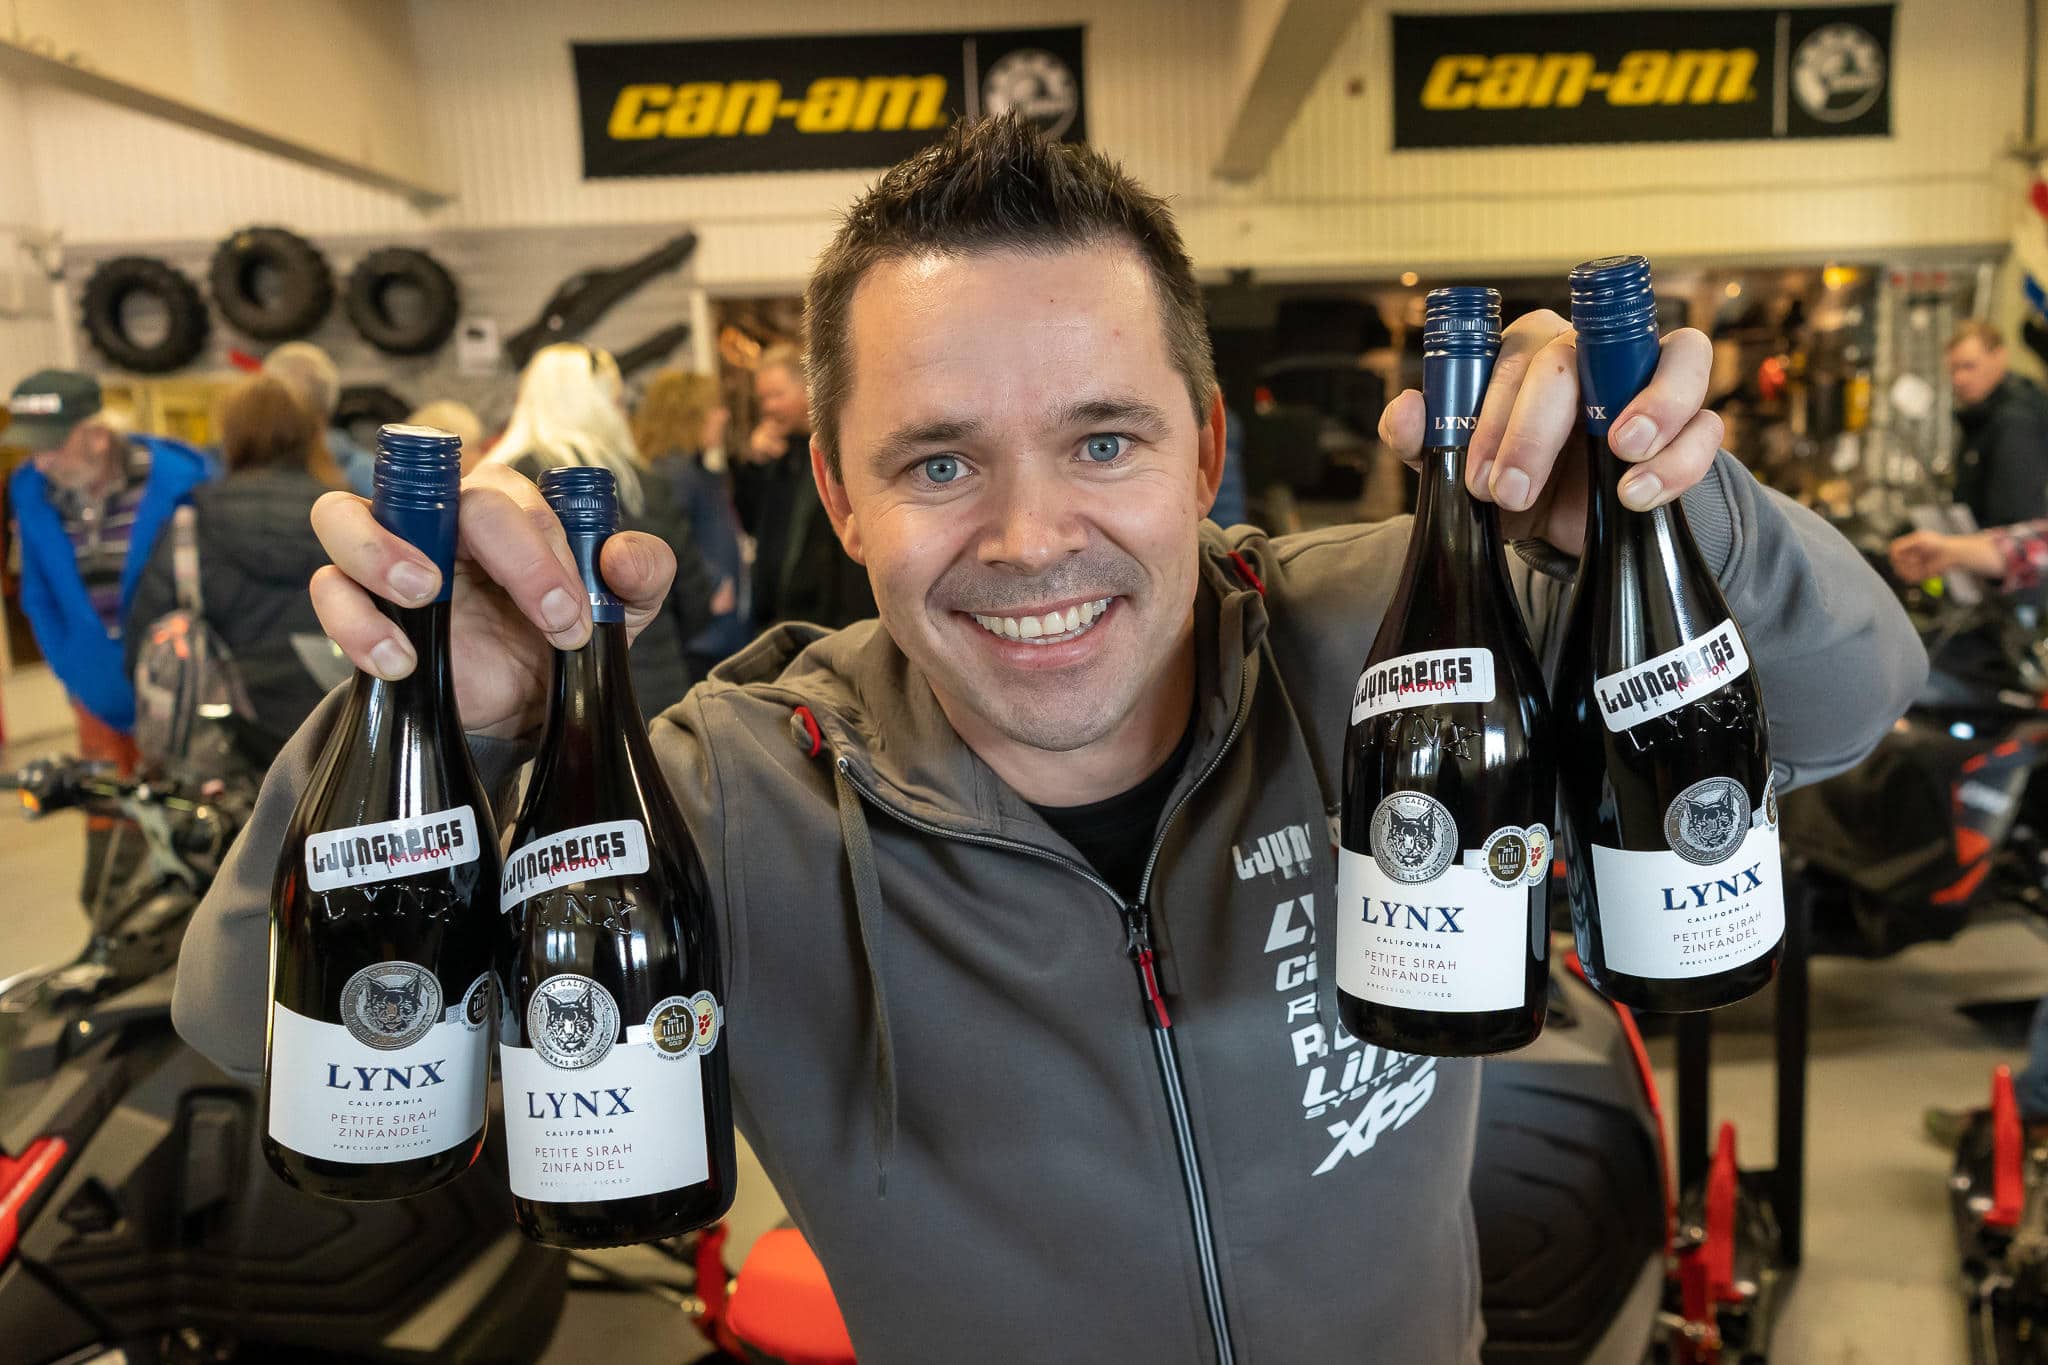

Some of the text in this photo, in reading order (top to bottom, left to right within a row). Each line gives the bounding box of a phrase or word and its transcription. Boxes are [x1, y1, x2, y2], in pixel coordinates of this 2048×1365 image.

[1420, 48, 1757, 109] can-am
[607, 74, 948, 140] can-am
[1399, 680, 1456, 696] Motor
[389, 847, 450, 867] Motor
[550, 855, 610, 877] Motor
[1661, 862, 1763, 911] LYNX
[1361, 896, 1465, 933] LYNX
[1687, 903, 1751, 923] CALIFORNIA
[1673, 912, 1762, 943] PETITE SIRAH
[1376, 936, 1442, 949] CALIFORNIA
[1682, 927, 1758, 954] ZINFANDEL
[1365, 950, 1457, 970] PETITE SIRAH
[1370, 965, 1449, 984] ZINFANDEL
[326, 1059, 447, 1091] LYNX
[348, 1097, 423, 1107] CALIFORNIA
[526, 1087, 635, 1119] LYNX
[331, 1109, 437, 1126] PETITE SIRAH
[338, 1126, 429, 1138] ZINFANDEL
[545, 1128, 615, 1137] CALIFORNIA
[535, 1143, 632, 1158] PETITE SIRAH
[542, 1159, 625, 1173] ZINFANDEL
